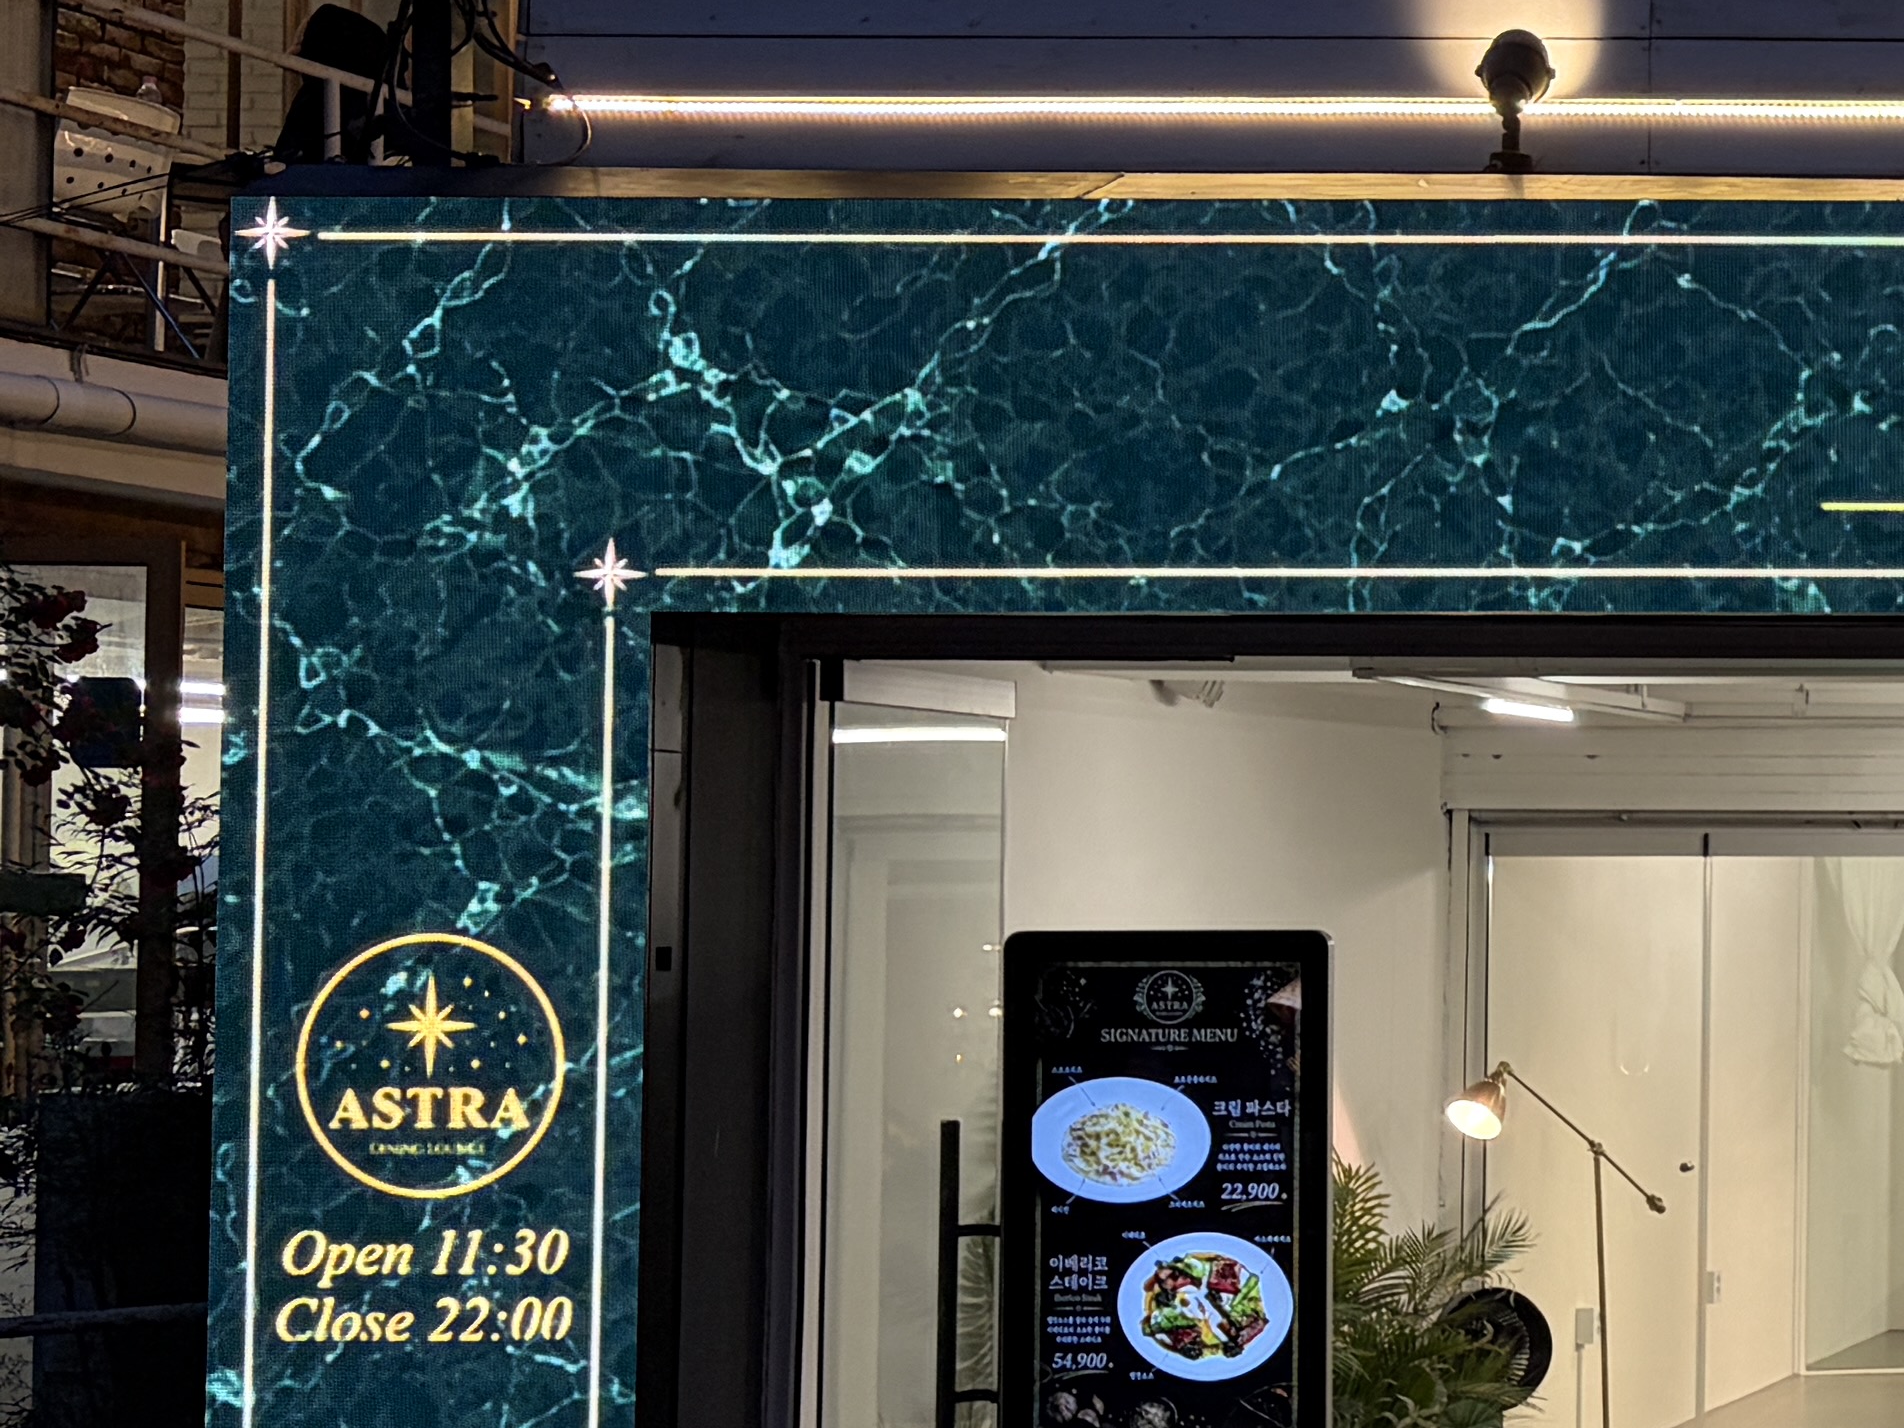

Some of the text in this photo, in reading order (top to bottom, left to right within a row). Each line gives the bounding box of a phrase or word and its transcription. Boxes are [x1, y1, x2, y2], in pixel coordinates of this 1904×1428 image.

[1151, 1000, 1189, 1011] ASTRA
[1100, 1027, 1239, 1043] SIGNATURE MENU
[328, 1086, 531, 1130] ASTRA
[1245, 1098, 1292, 1118] 파스타
[1220, 1182, 1280, 1202] 22,900
[281, 1228, 570, 1290] Open 11:30
[1048, 1253, 1109, 1273] 이베리코
[1048, 1273, 1109, 1291] 스테이크
[275, 1295, 574, 1343] Close 22:00
[1051, 1352, 1108, 1370] 54,900
